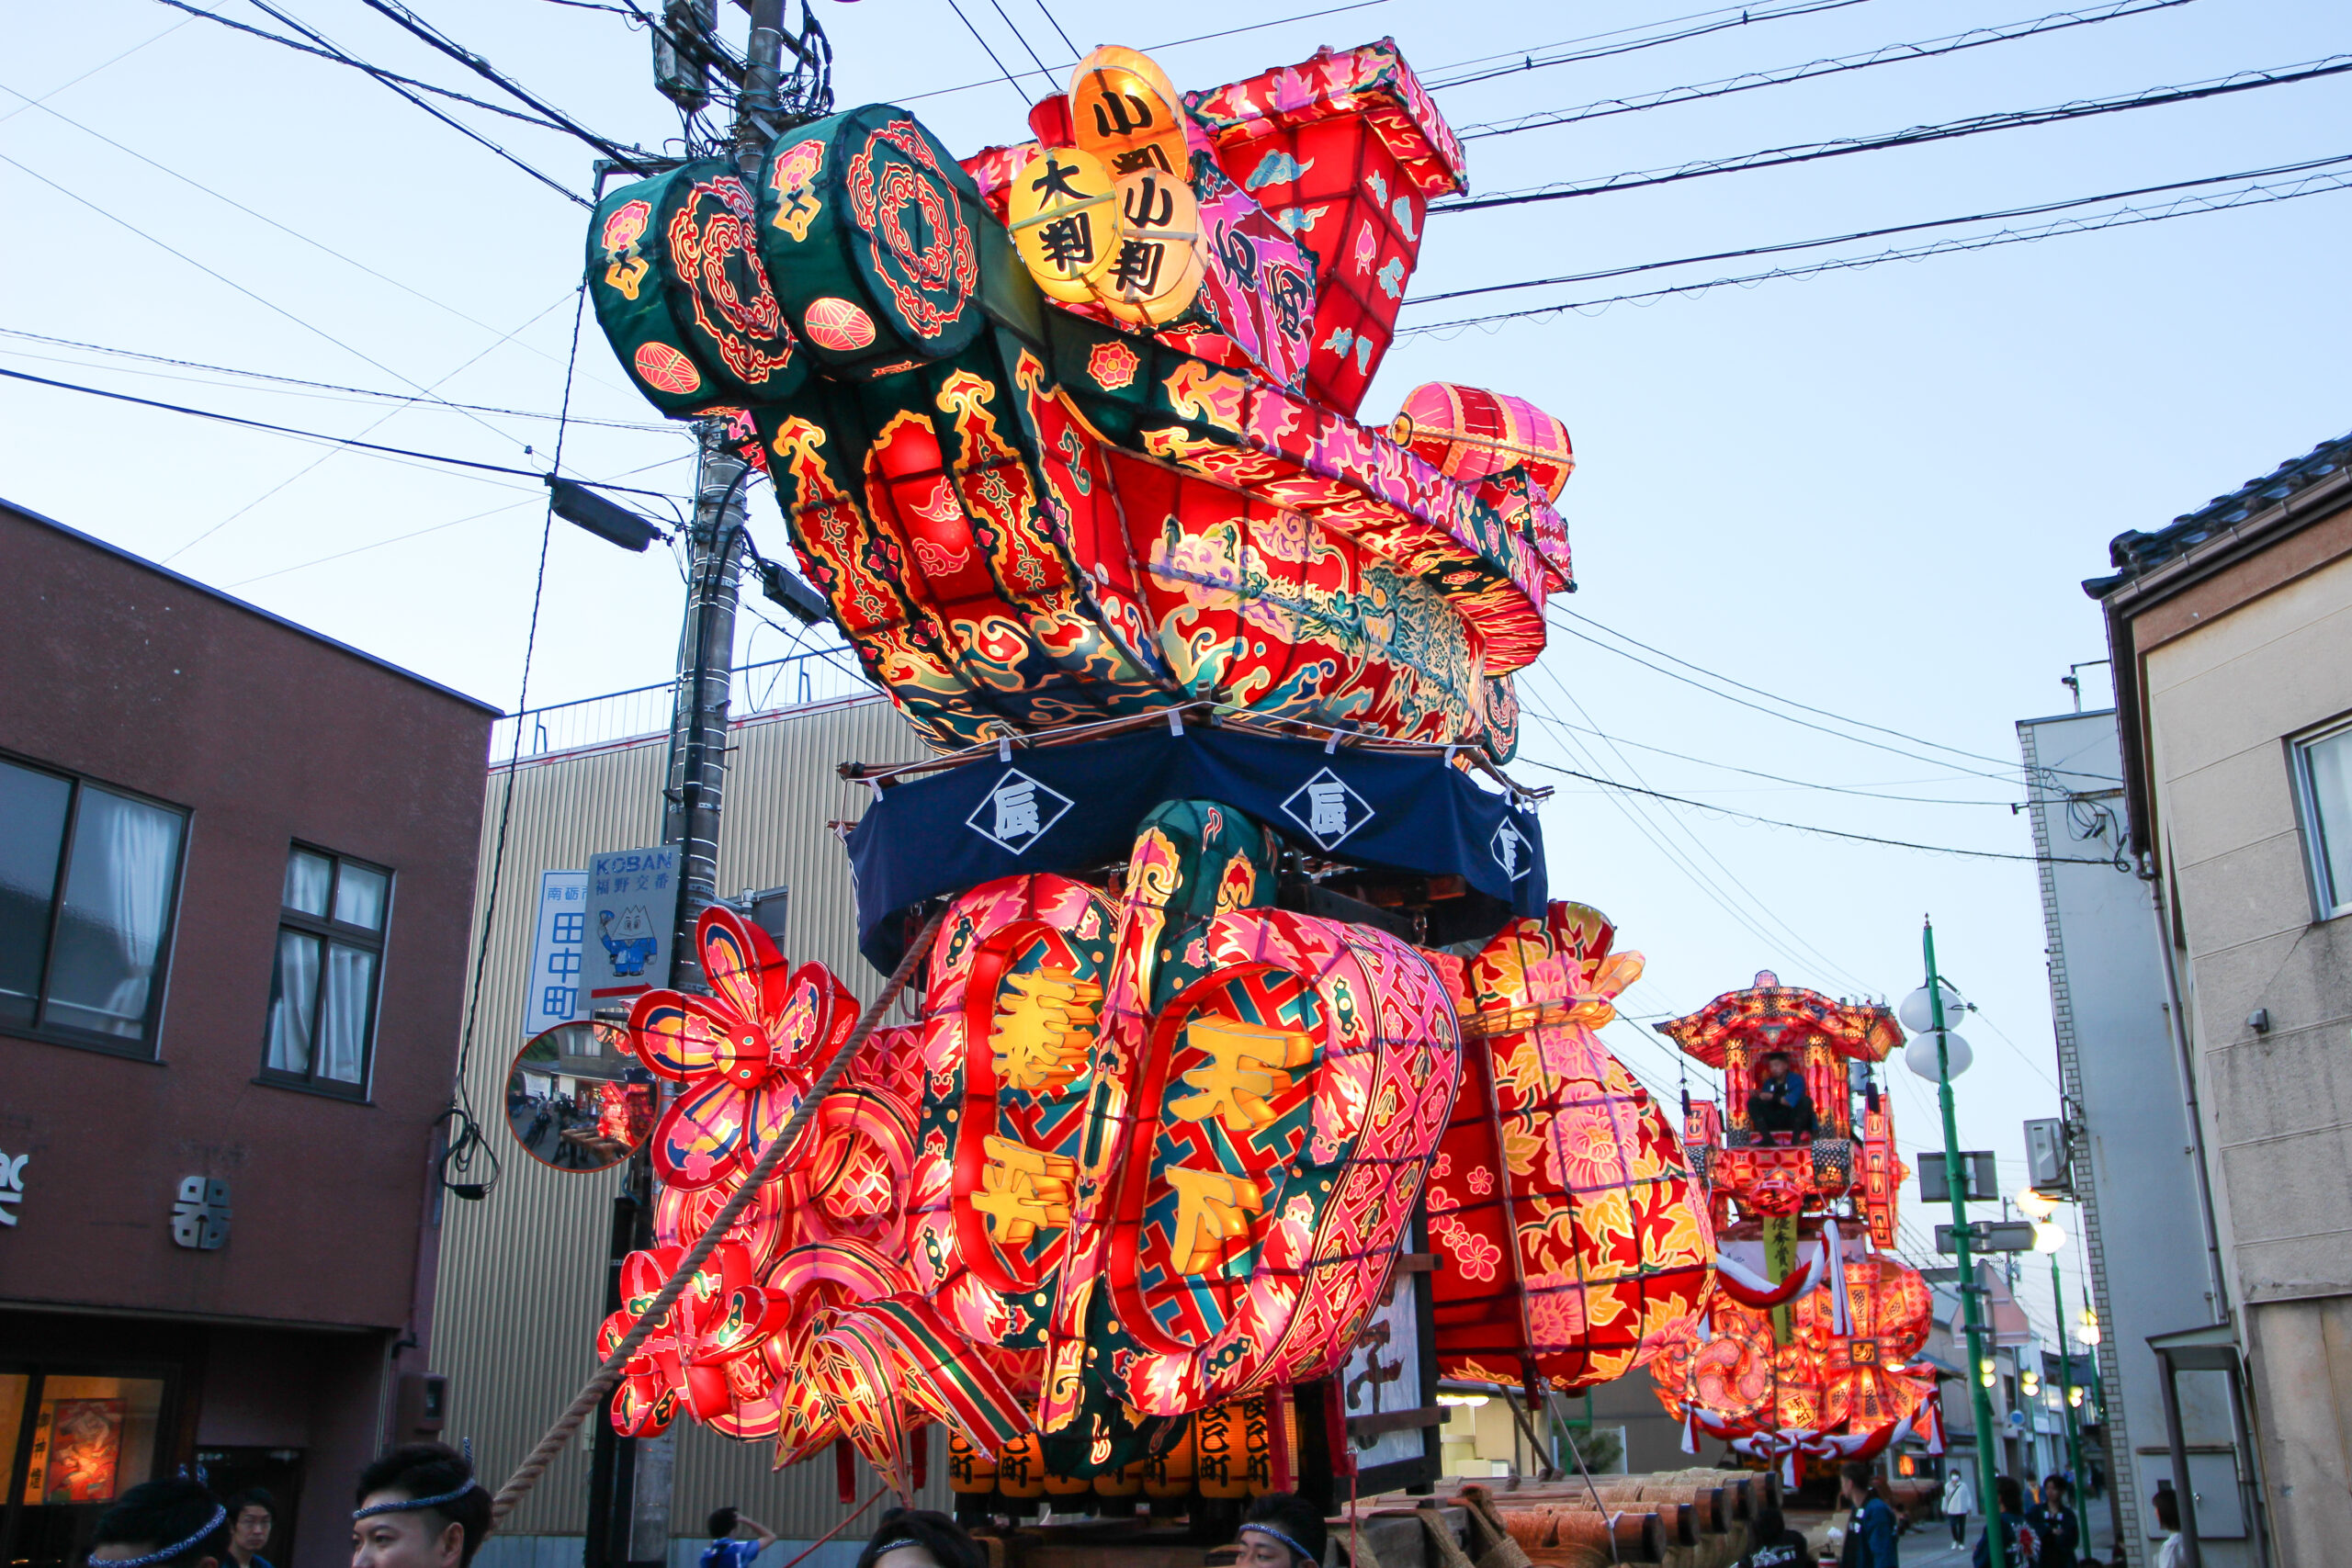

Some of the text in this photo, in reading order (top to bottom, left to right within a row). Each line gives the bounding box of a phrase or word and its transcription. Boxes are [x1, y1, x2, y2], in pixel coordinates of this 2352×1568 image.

[1032, 160, 1095, 272] 大判
[1108, 176, 1173, 296] 小判
[993, 781, 1040, 840] 辰
[1307, 782, 1348, 836] 辰
[595, 873, 670, 896] 福野交番
[596, 852, 673, 875] KOBAN
[542, 912, 585, 1021] 田中町
[1164, 1014, 1311, 1276] 天下
